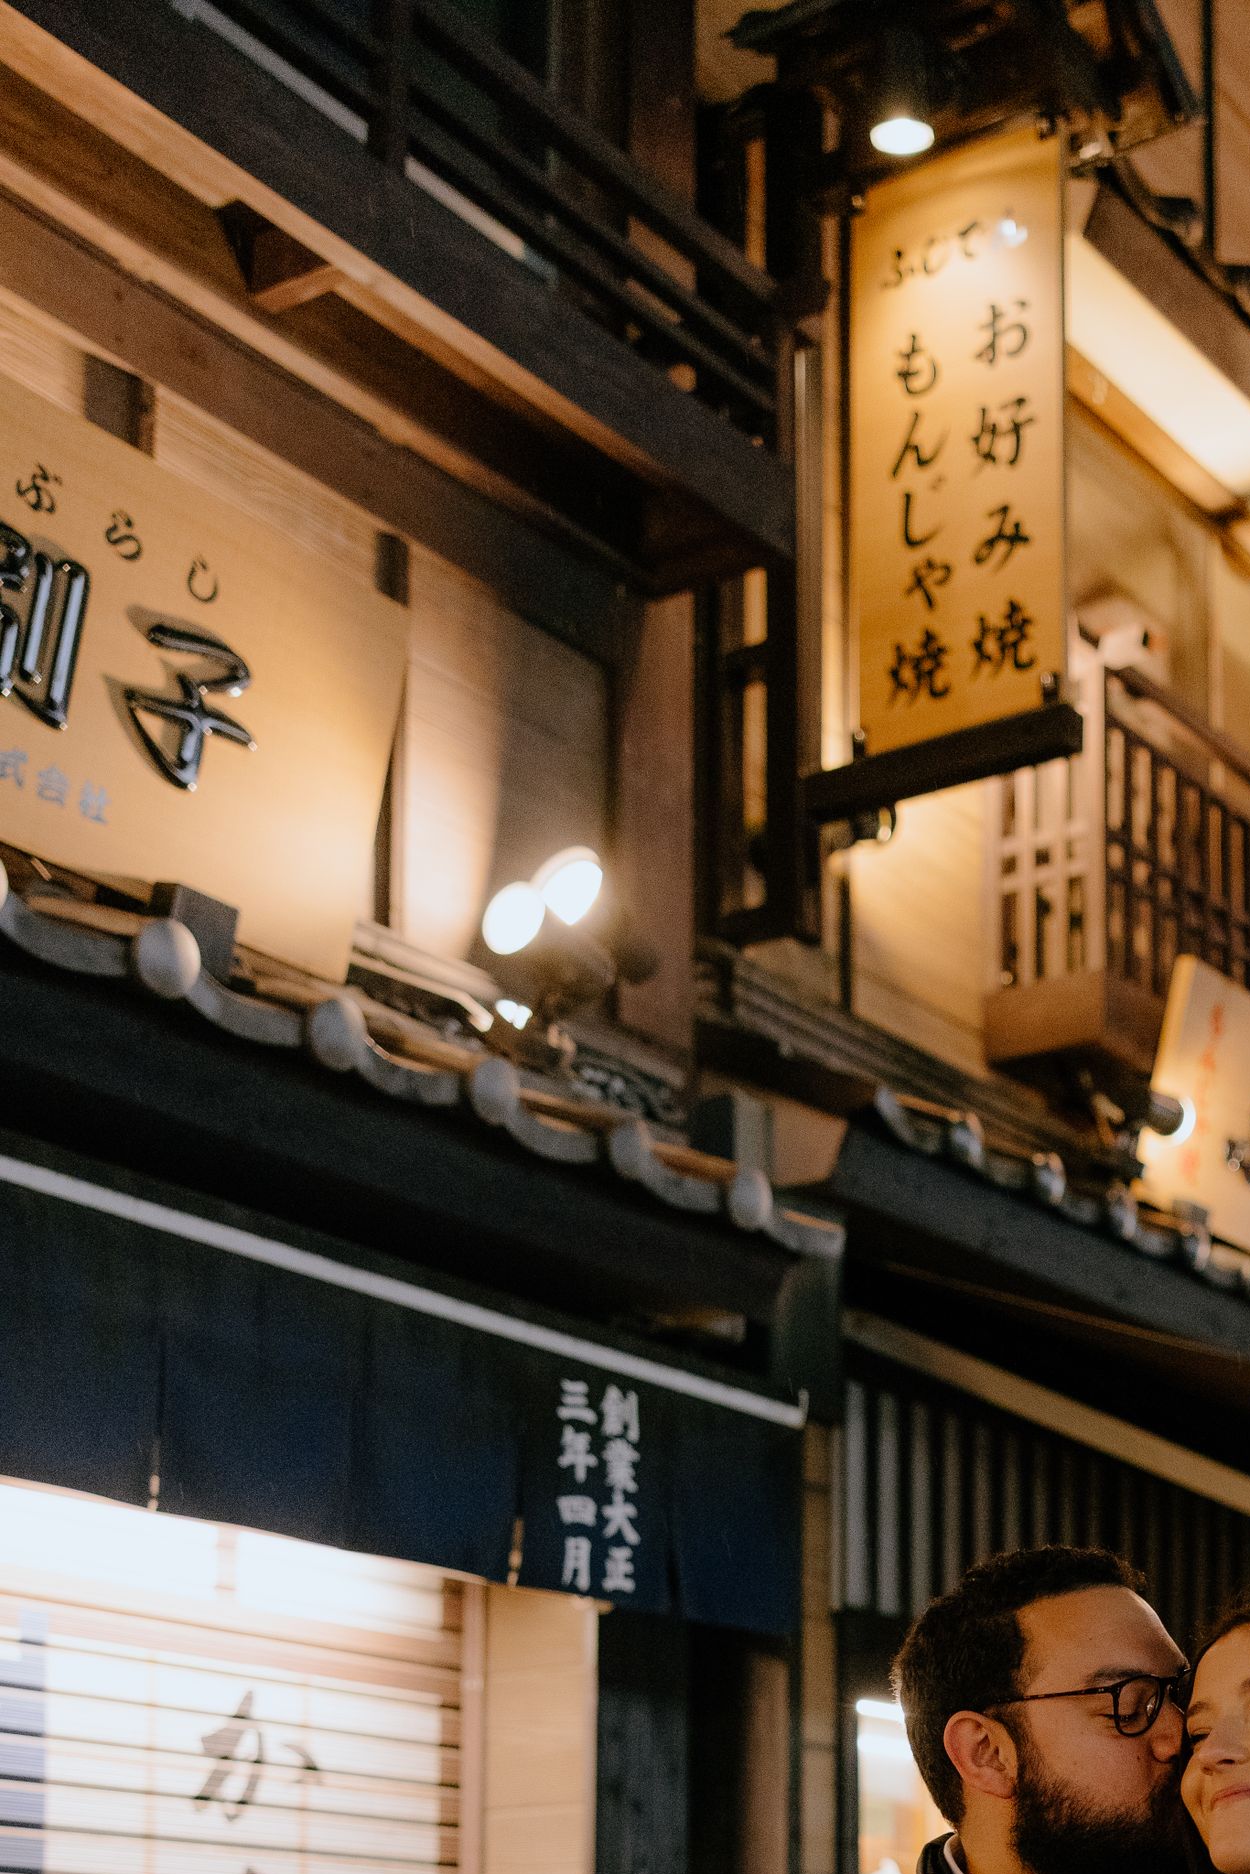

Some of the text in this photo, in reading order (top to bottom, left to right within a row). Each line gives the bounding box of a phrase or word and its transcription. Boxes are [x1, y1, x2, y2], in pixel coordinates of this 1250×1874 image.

[884, 333, 955, 709] もんじゃ焼
[971, 299, 1038, 676] お好み焼
[556, 1378, 598, 1592] 三年四月
[601, 1383, 641, 1594] 創業大正
